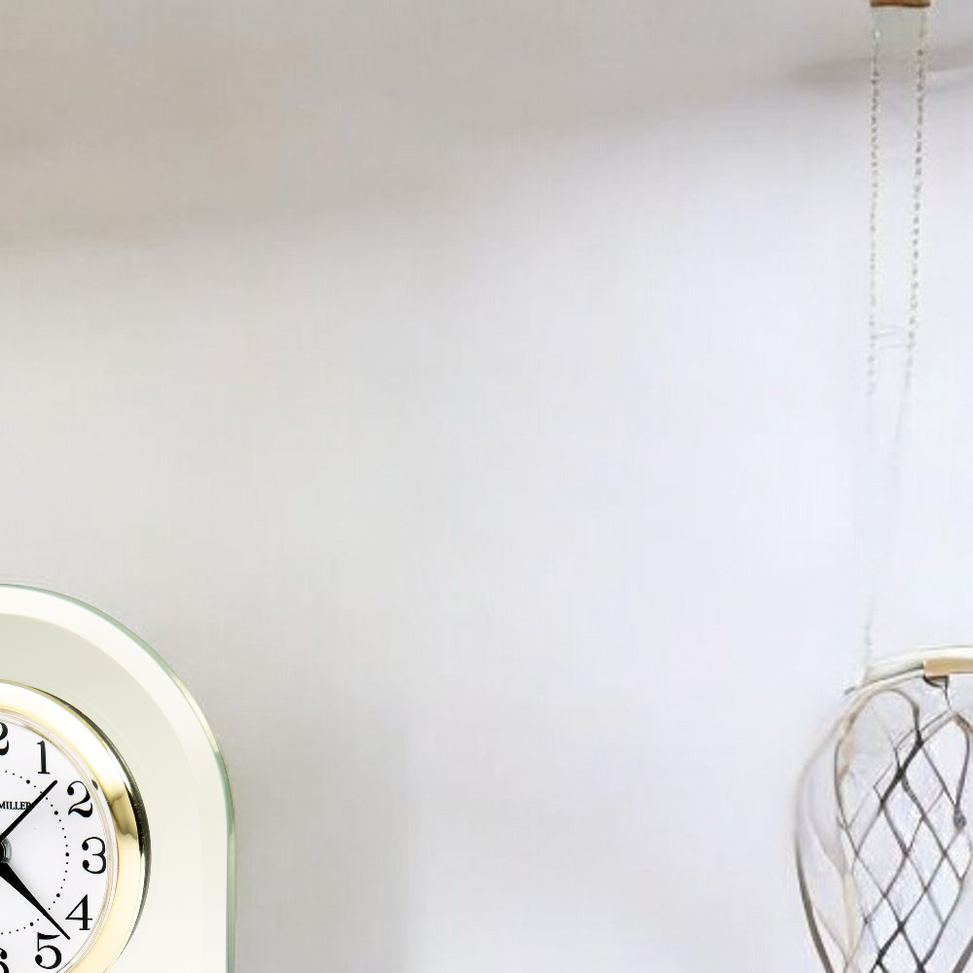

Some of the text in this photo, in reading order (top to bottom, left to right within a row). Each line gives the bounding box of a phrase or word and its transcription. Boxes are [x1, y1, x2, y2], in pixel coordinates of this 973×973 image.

[37, 740, 51, 775] 1
[66, 780, 94, 818] 2
[81, 836, 107, 875] 3
[65, 894, 93, 931] 4
[35, 931, 62, 970] 5
